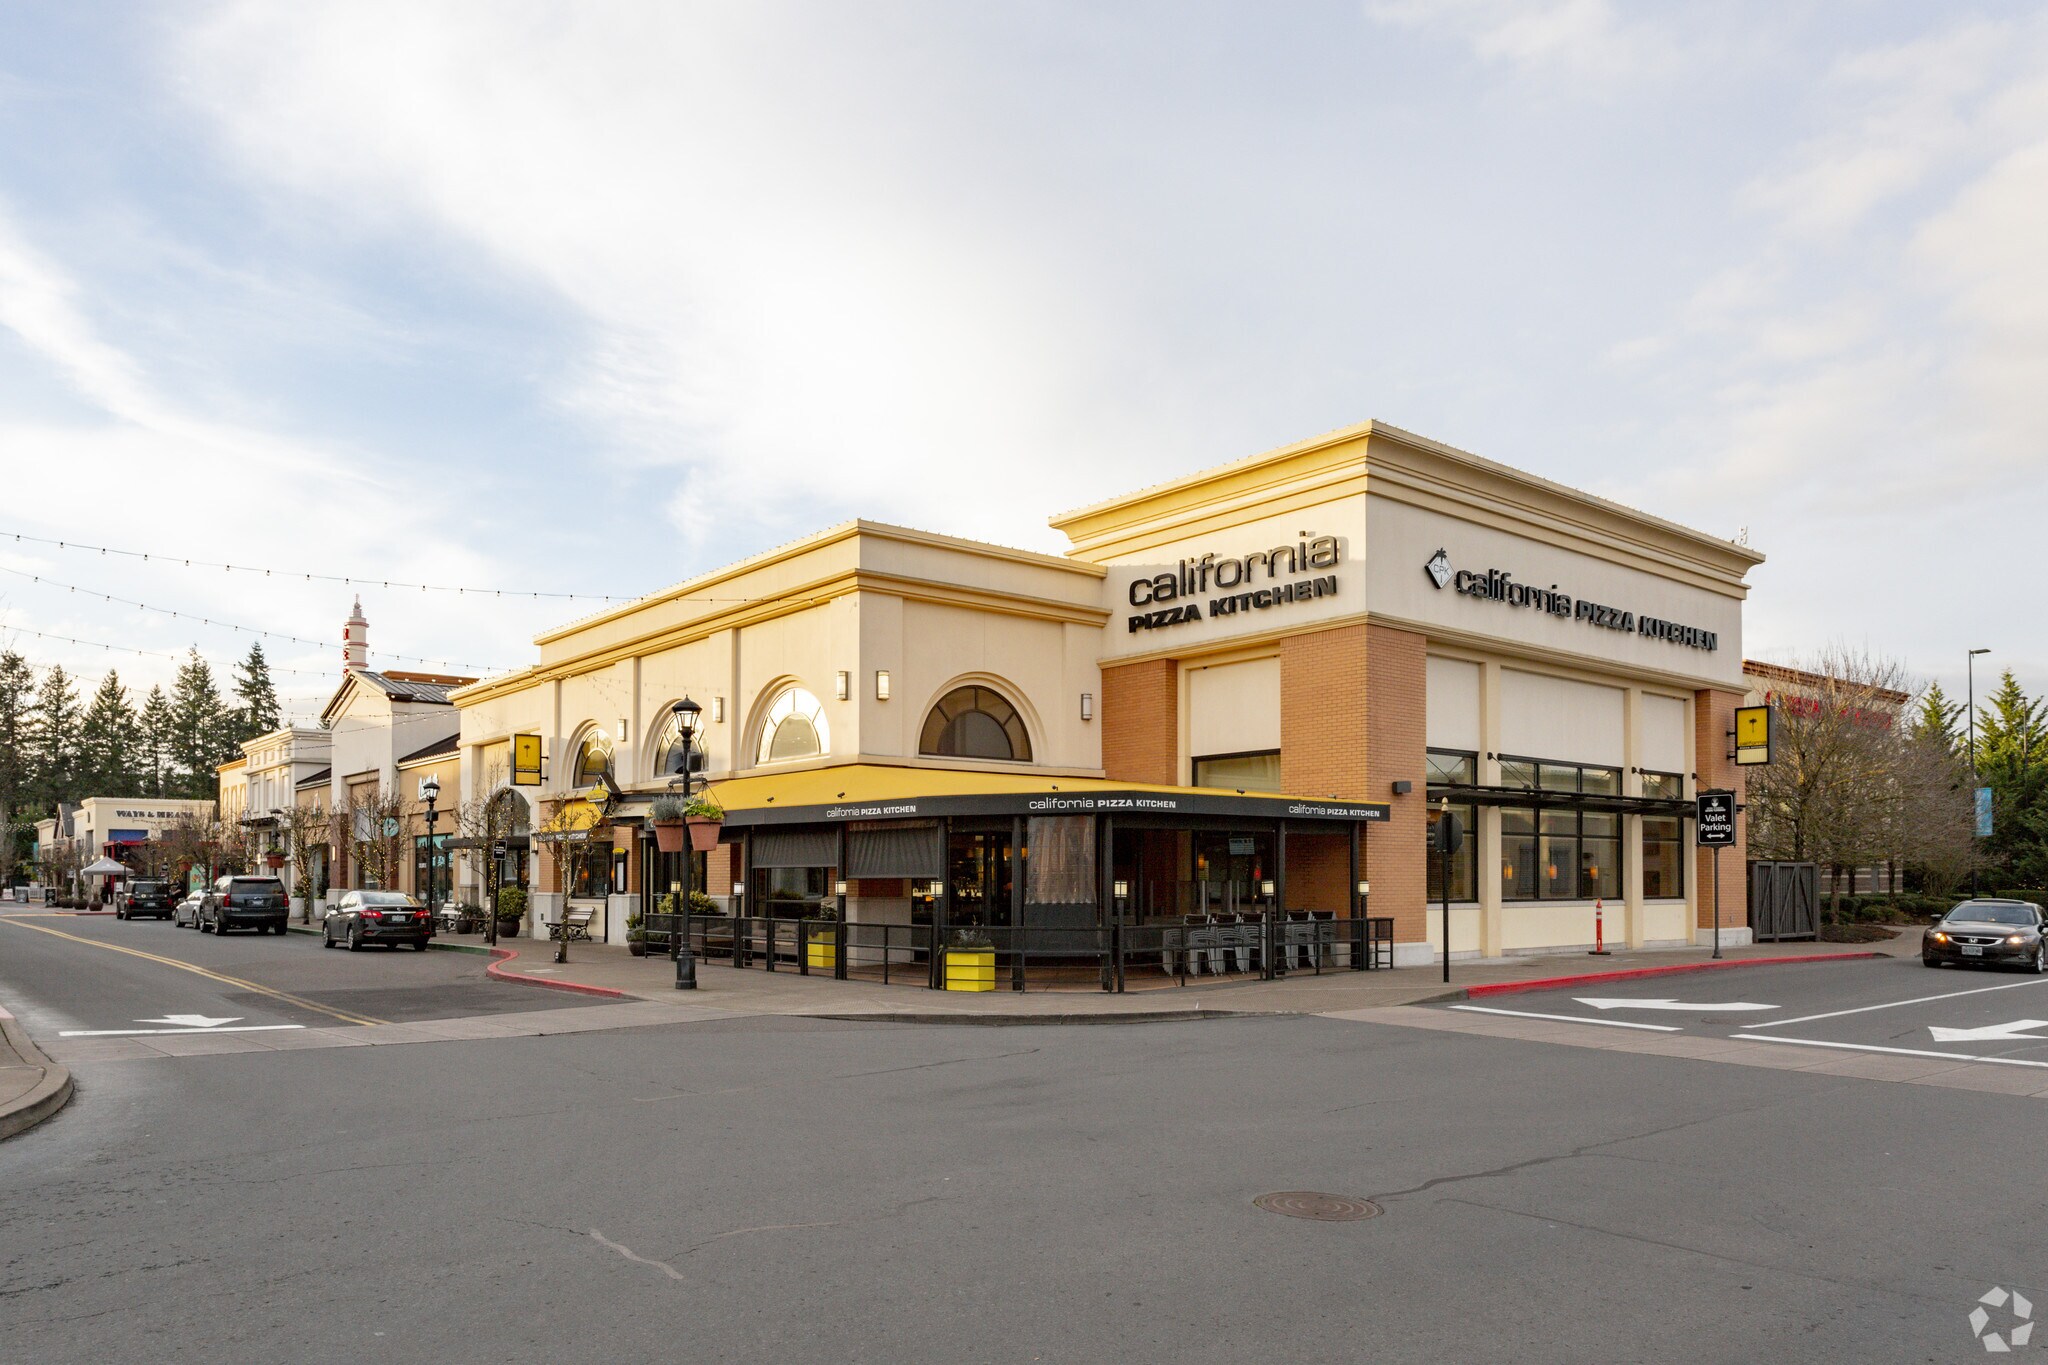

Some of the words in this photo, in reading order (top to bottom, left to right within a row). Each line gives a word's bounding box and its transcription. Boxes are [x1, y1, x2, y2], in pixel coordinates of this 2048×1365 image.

[1128, 530, 1340, 607] california
[1433, 563, 1450, 576] CPK
[1128, 604, 1202, 634] PIZZA
[1209, 575, 1338, 618] KITCHEN
[1455, 568, 1572, 618] california
[1575, 600, 1636, 633] PIZZA
[1639, 615, 1718, 651] KITCHEN
[1028, 797, 1094, 810] california
[1097, 799, 1134, 808] PIZZA
[1136, 799, 1177, 809] KITCHEN
[116, 810, 146, 818] WAYS
[826, 806, 860, 818] california
[860, 807, 882, 816] PIZZA
[883, 805, 917, 815] KITCHEN
[1288, 803, 1326, 815] california
[1327, 808, 1348, 816] PIZZA
[1349, 809, 1381, 818] KITCHEN
[1704, 813, 1727, 822] Valet
[1700, 823, 1732, 833] Parking
